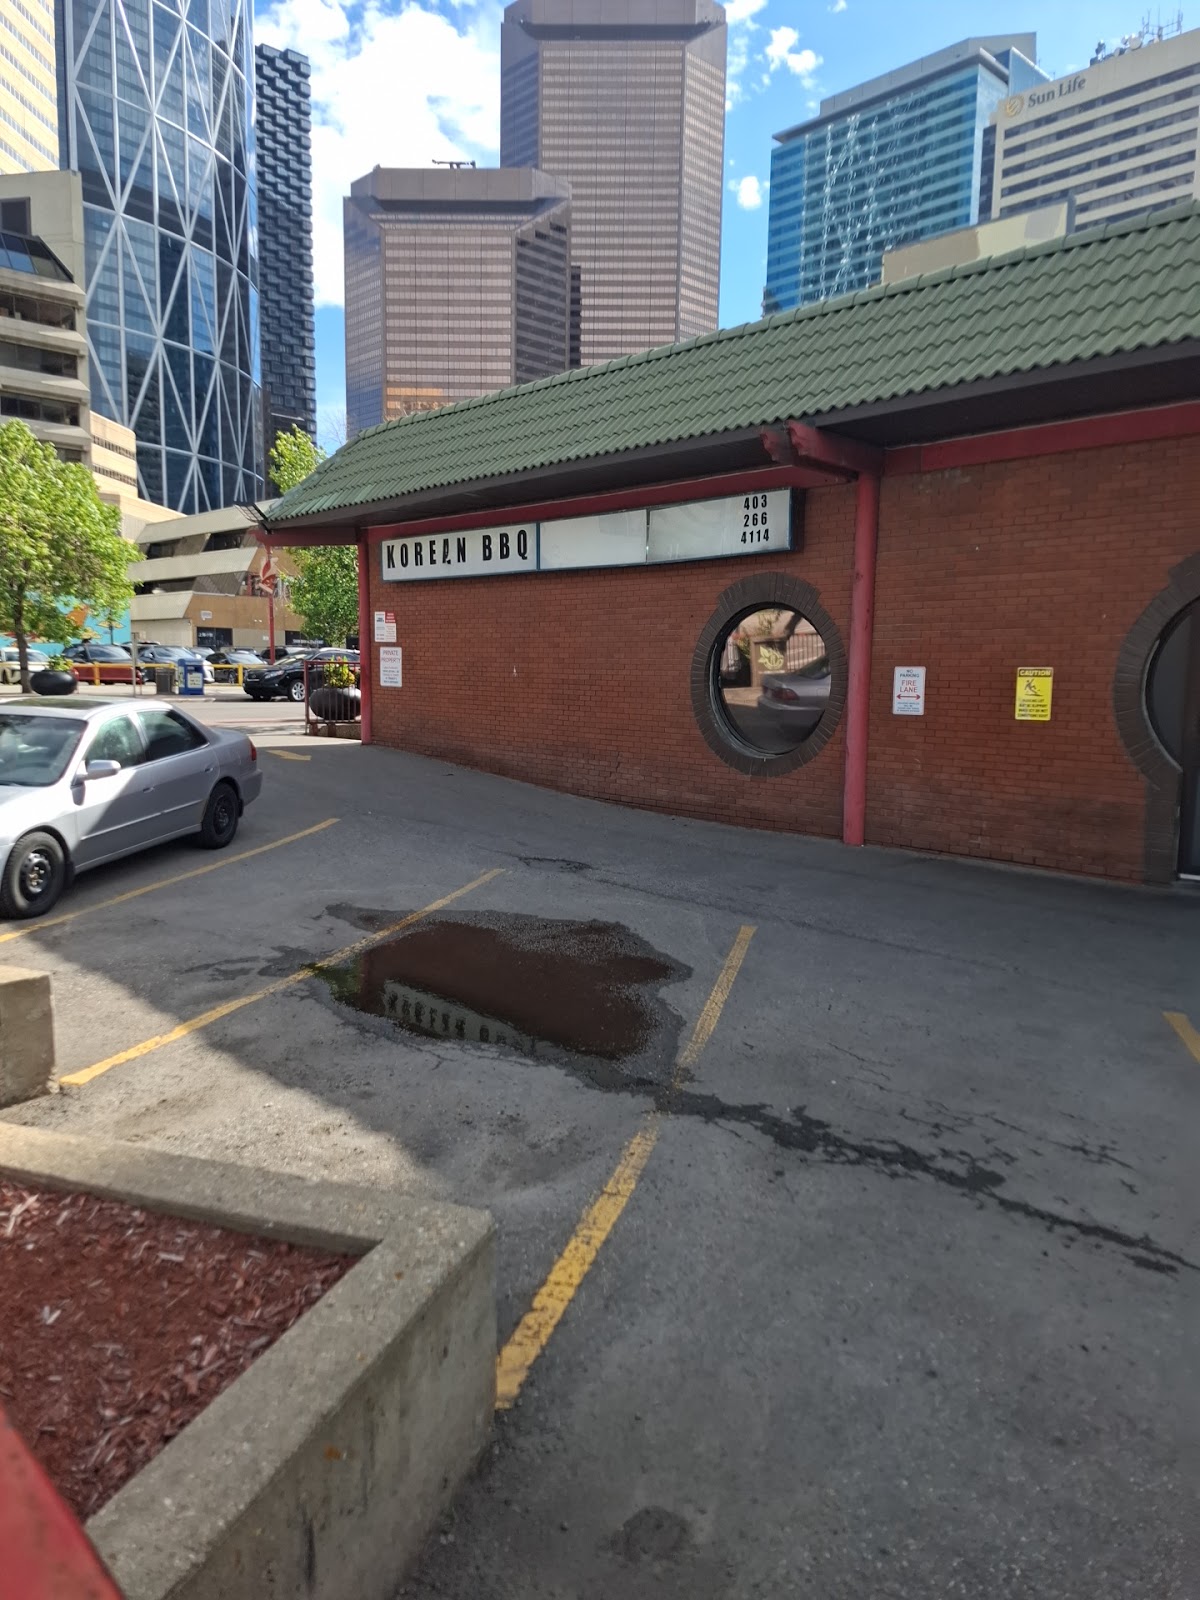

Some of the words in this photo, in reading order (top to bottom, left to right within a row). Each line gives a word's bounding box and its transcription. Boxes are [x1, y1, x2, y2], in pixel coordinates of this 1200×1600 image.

[1027, 90, 1055, 108] Sun
[1058, 75, 1086, 97] Life
[743, 494, 767, 510] 403
[743, 511, 767, 527] 266
[740, 528, 769, 544] 4114
[386, 537, 466, 569] KOREAN
[482, 529, 528, 561] BBQ
[901, 679, 917, 687] FIRE
